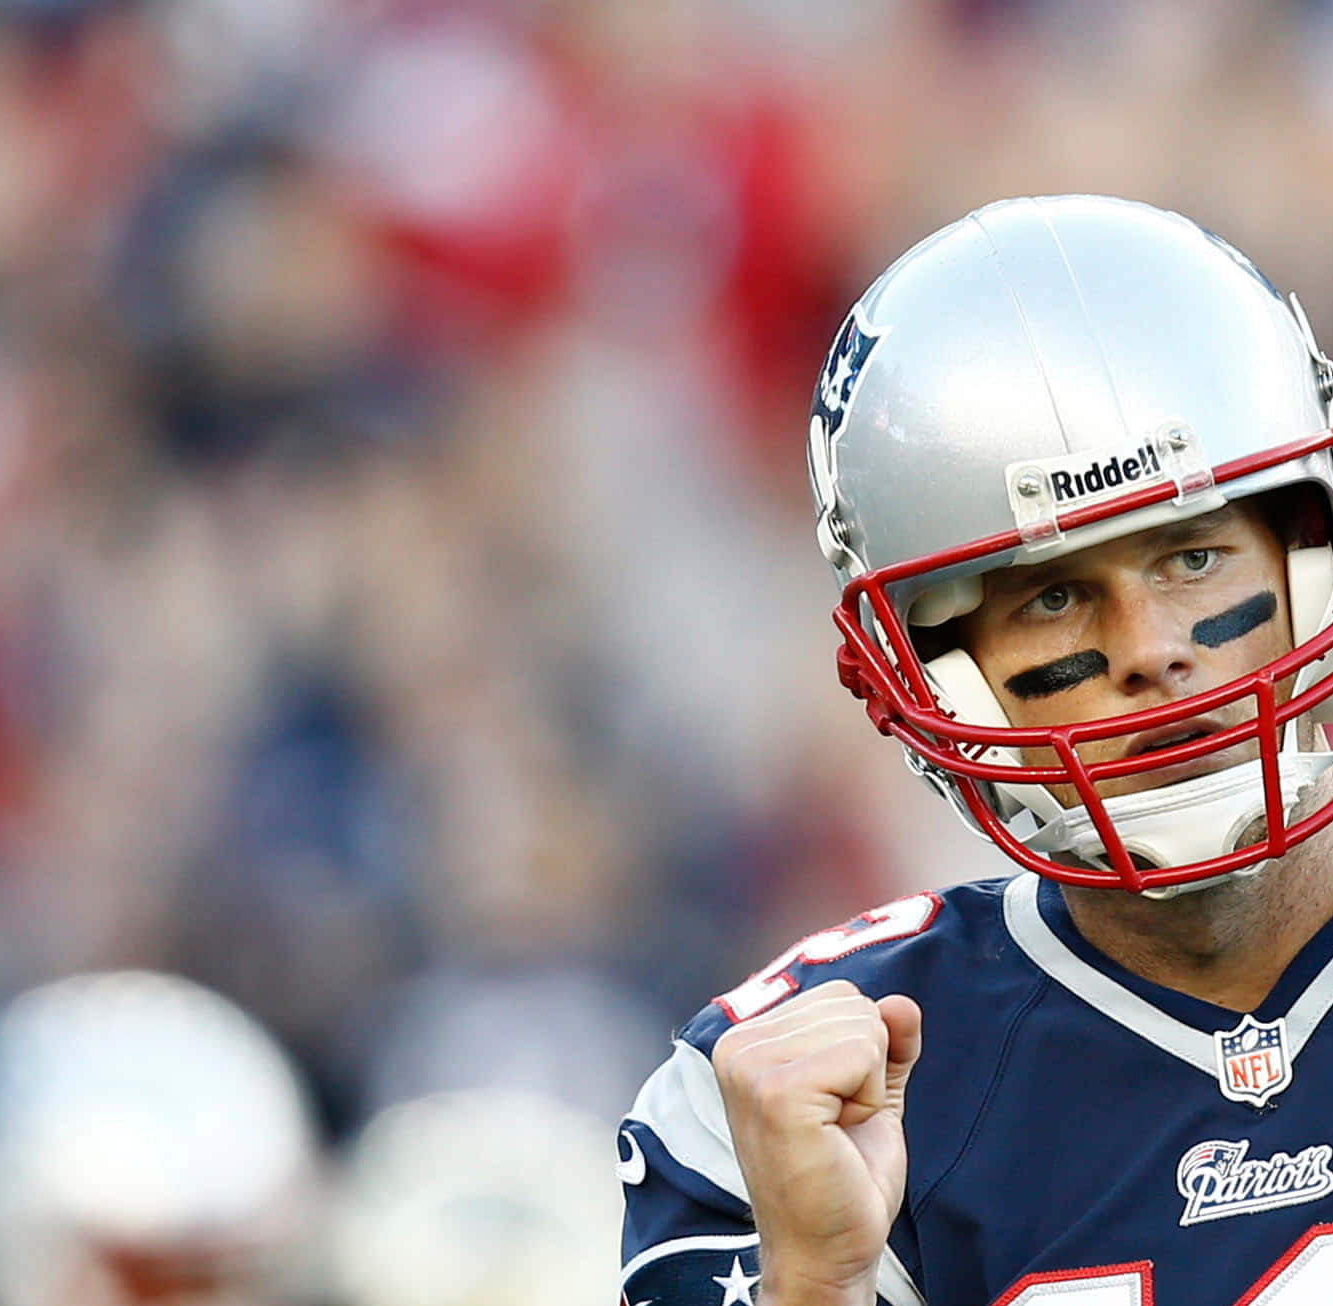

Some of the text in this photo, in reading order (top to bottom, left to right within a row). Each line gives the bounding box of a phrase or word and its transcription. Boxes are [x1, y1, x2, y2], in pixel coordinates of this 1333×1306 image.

[1051, 443, 1162, 501] Riddell
[1229, 1050, 1281, 1089] NFL
[1182, 1144, 1333, 1220] Patriots
